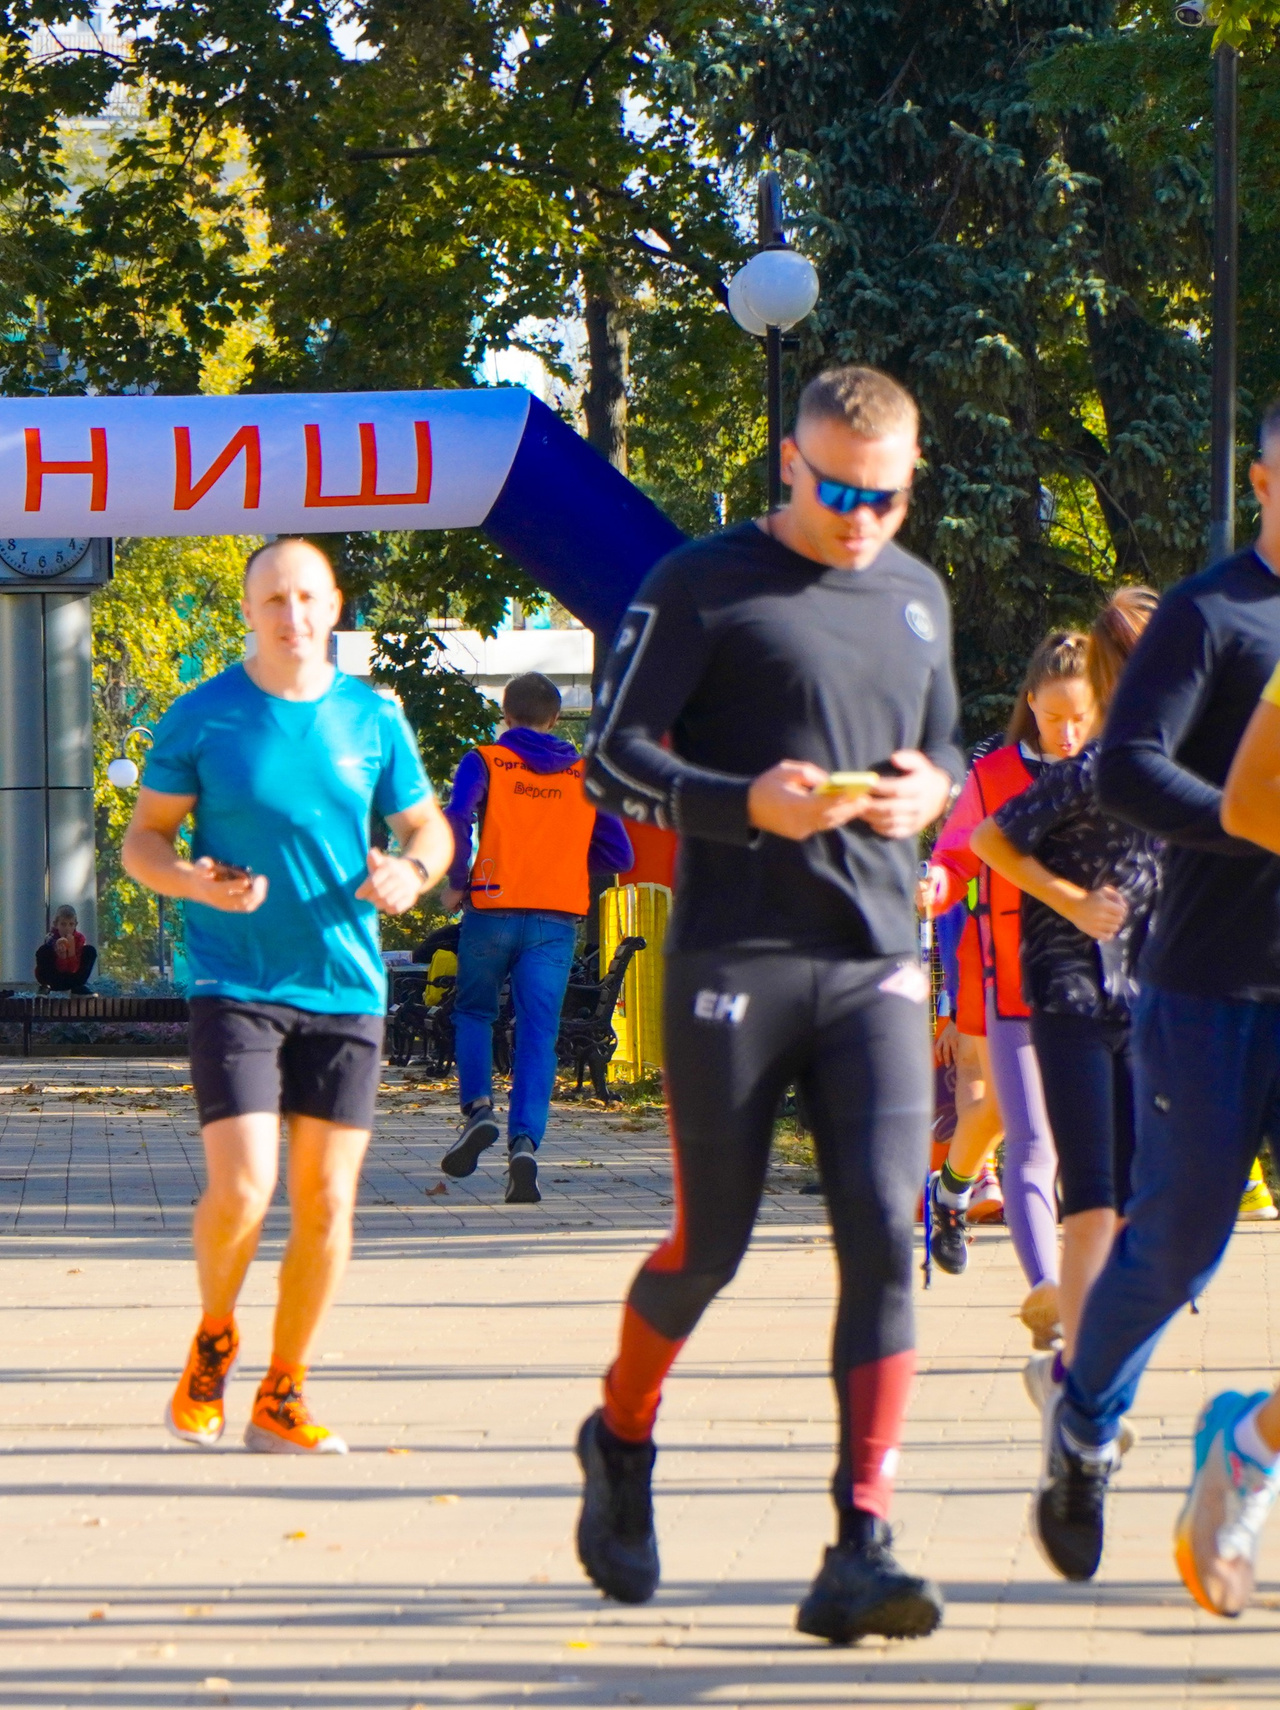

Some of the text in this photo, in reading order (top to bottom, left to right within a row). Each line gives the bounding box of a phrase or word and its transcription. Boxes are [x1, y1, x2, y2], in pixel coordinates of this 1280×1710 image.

[7, 538, 17, 551] 8
[68, 538, 76, 550] 4
[20, 551, 28, 564] 7
[38, 555, 47, 568] 6
[55, 551, 64, 563] 5
[493, 757, 581, 779] Оргаор
